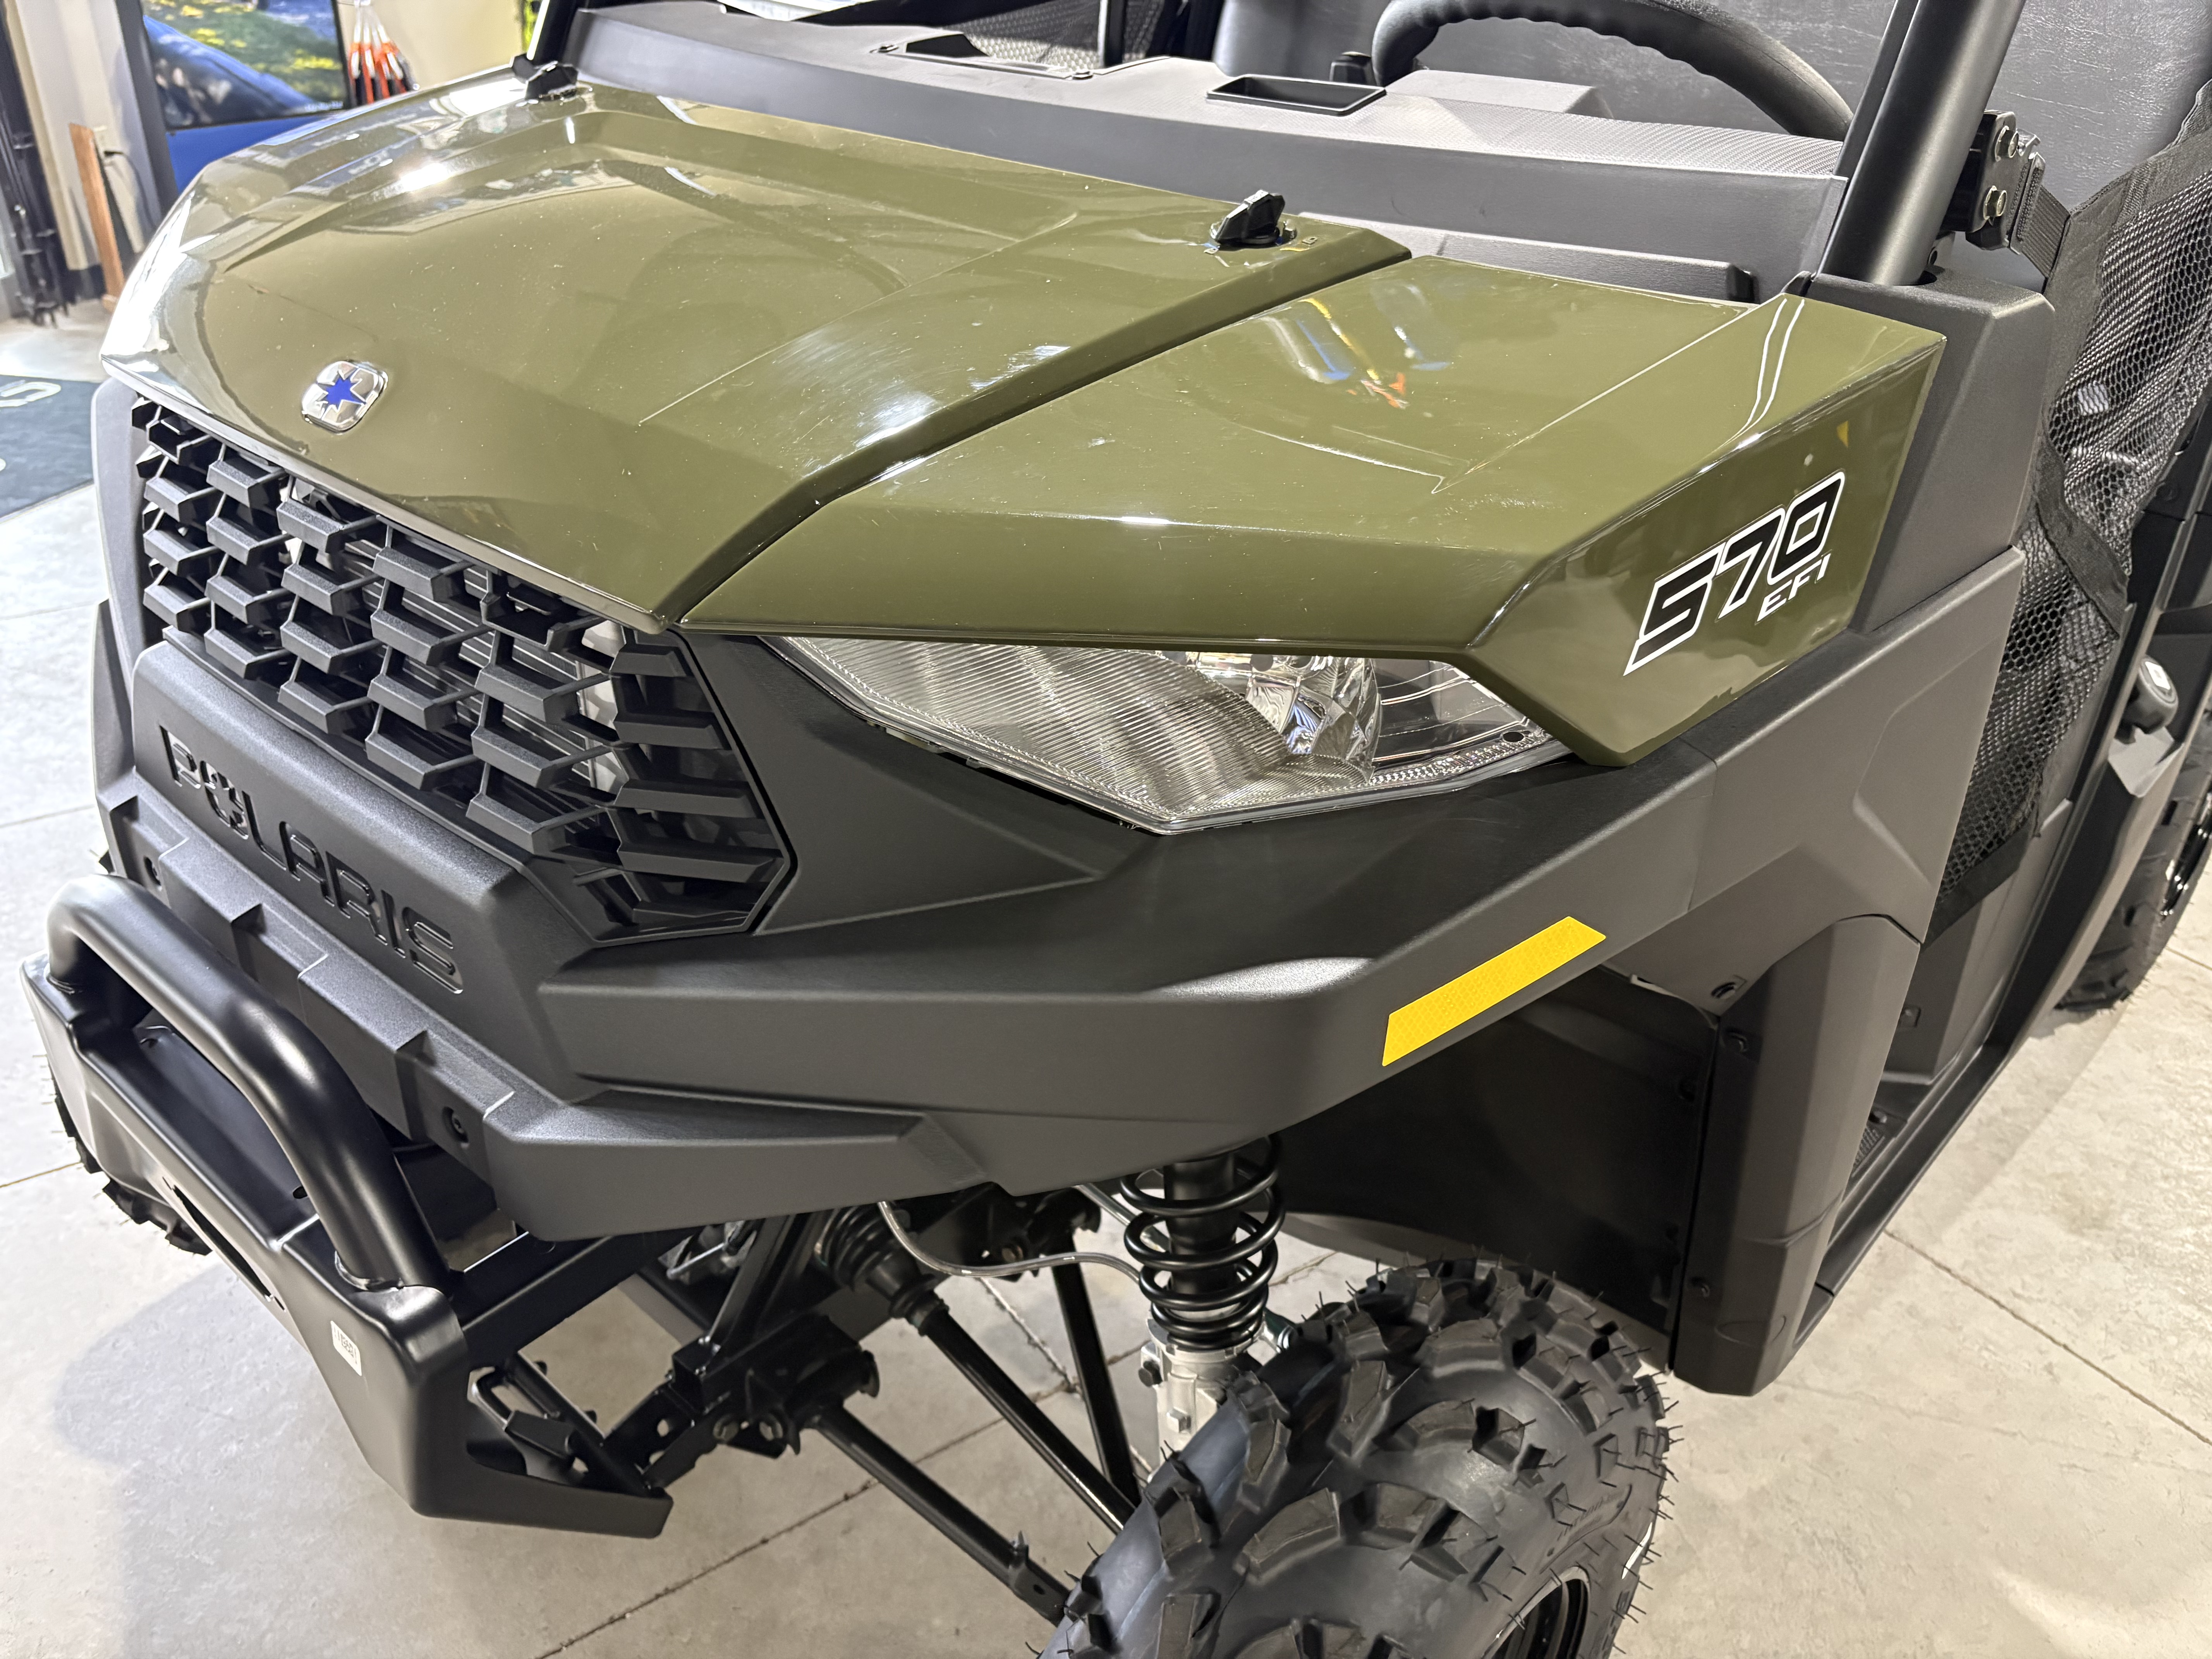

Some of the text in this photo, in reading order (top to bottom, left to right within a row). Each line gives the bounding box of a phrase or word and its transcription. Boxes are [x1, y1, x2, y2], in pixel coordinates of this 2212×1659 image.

[1623, 471, 1844, 676] 570
[1757, 553, 1831, 622] EFI
[159, 724, 463, 994] POLARIS
